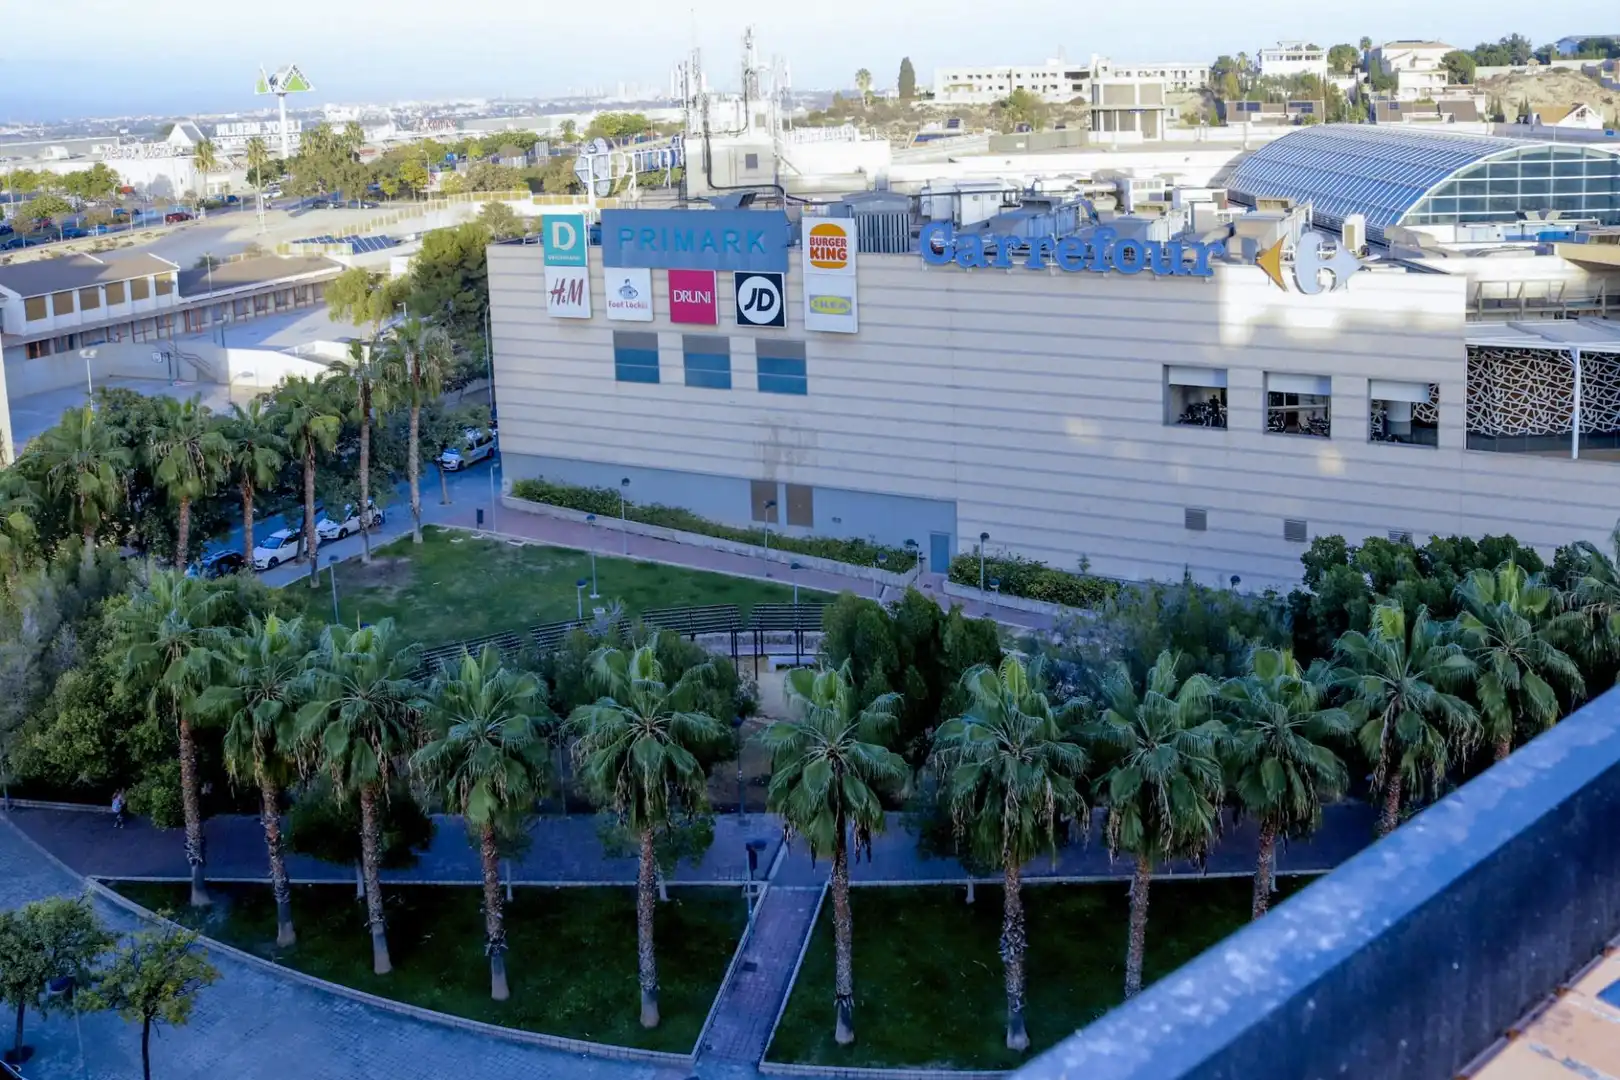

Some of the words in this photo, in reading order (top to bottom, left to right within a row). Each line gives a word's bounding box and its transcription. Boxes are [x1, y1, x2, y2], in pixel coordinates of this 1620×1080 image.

[551, 221, 577, 250] D
[617, 226, 766, 254] PRIMARK
[810, 236, 848, 248] BURGER
[810, 247, 848, 261] KING
[919, 220, 1225, 277] Carrefour
[548, 277, 584, 307] H&M
[608, 300, 624, 308] Foot
[673, 289, 712, 304] DRUNI
[743, 287, 775, 312] JD
